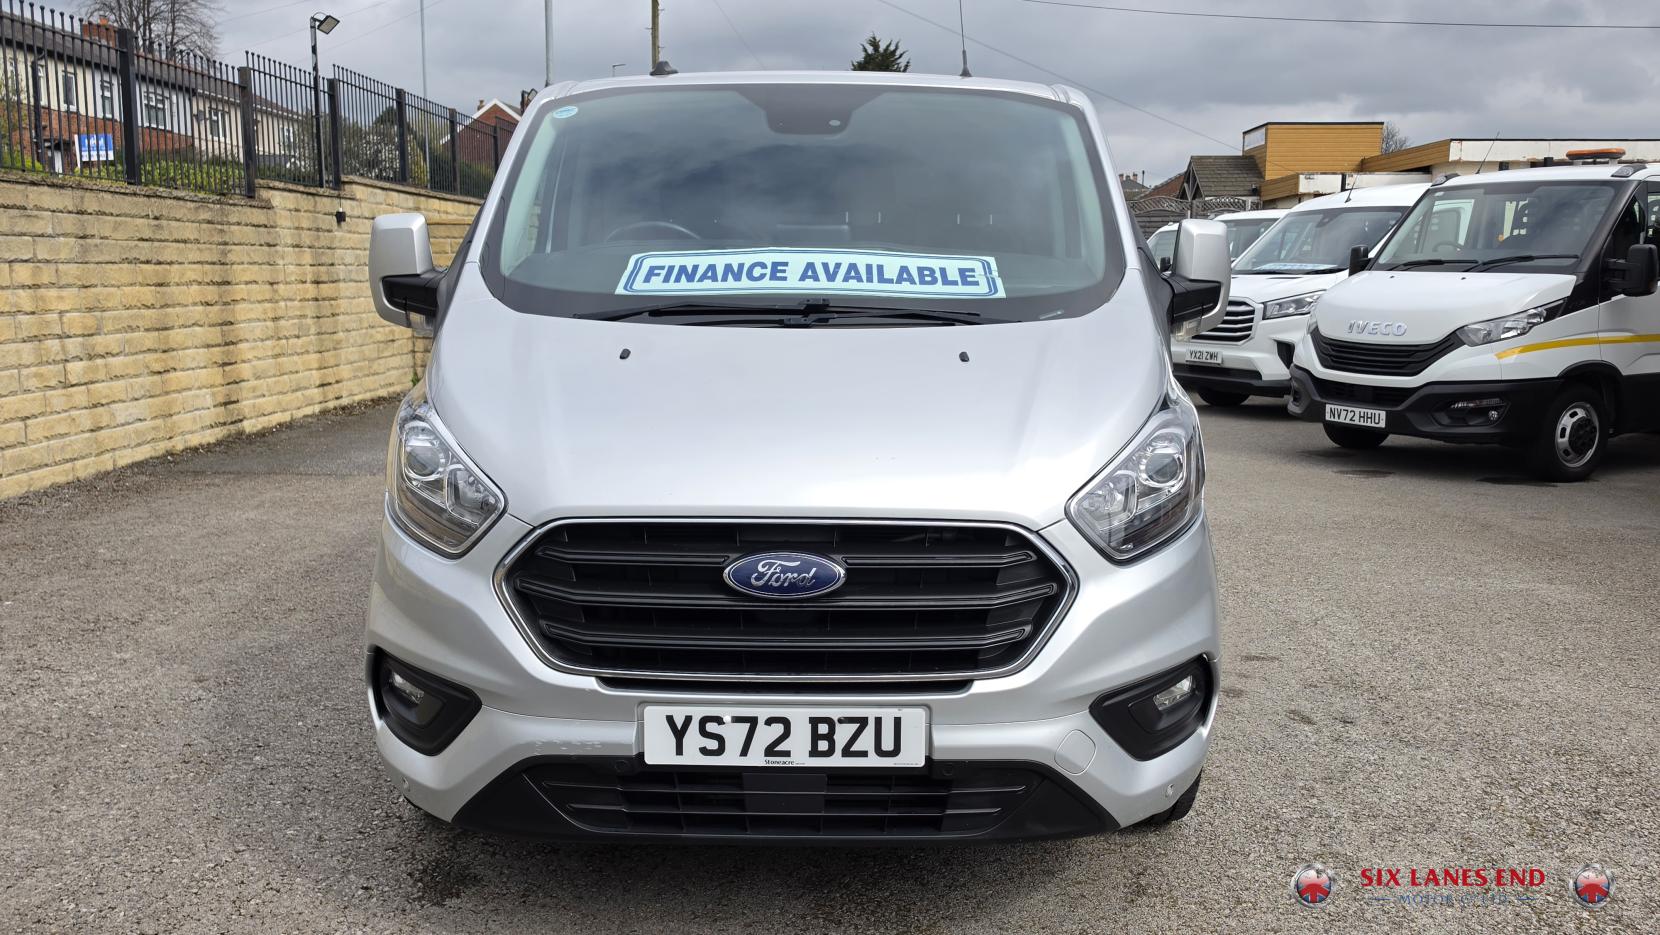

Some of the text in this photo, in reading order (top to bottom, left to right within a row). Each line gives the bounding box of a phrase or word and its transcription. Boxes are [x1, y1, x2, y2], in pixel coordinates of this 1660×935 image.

[643, 261, 981, 287] FINANCE AVAILABLE
[1347, 320, 1407, 336] IVECO
[1329, 407, 1381, 425] NV72 HHU
[750, 559, 817, 587] Ford
[665, 714, 902, 758] YS72 BZU
